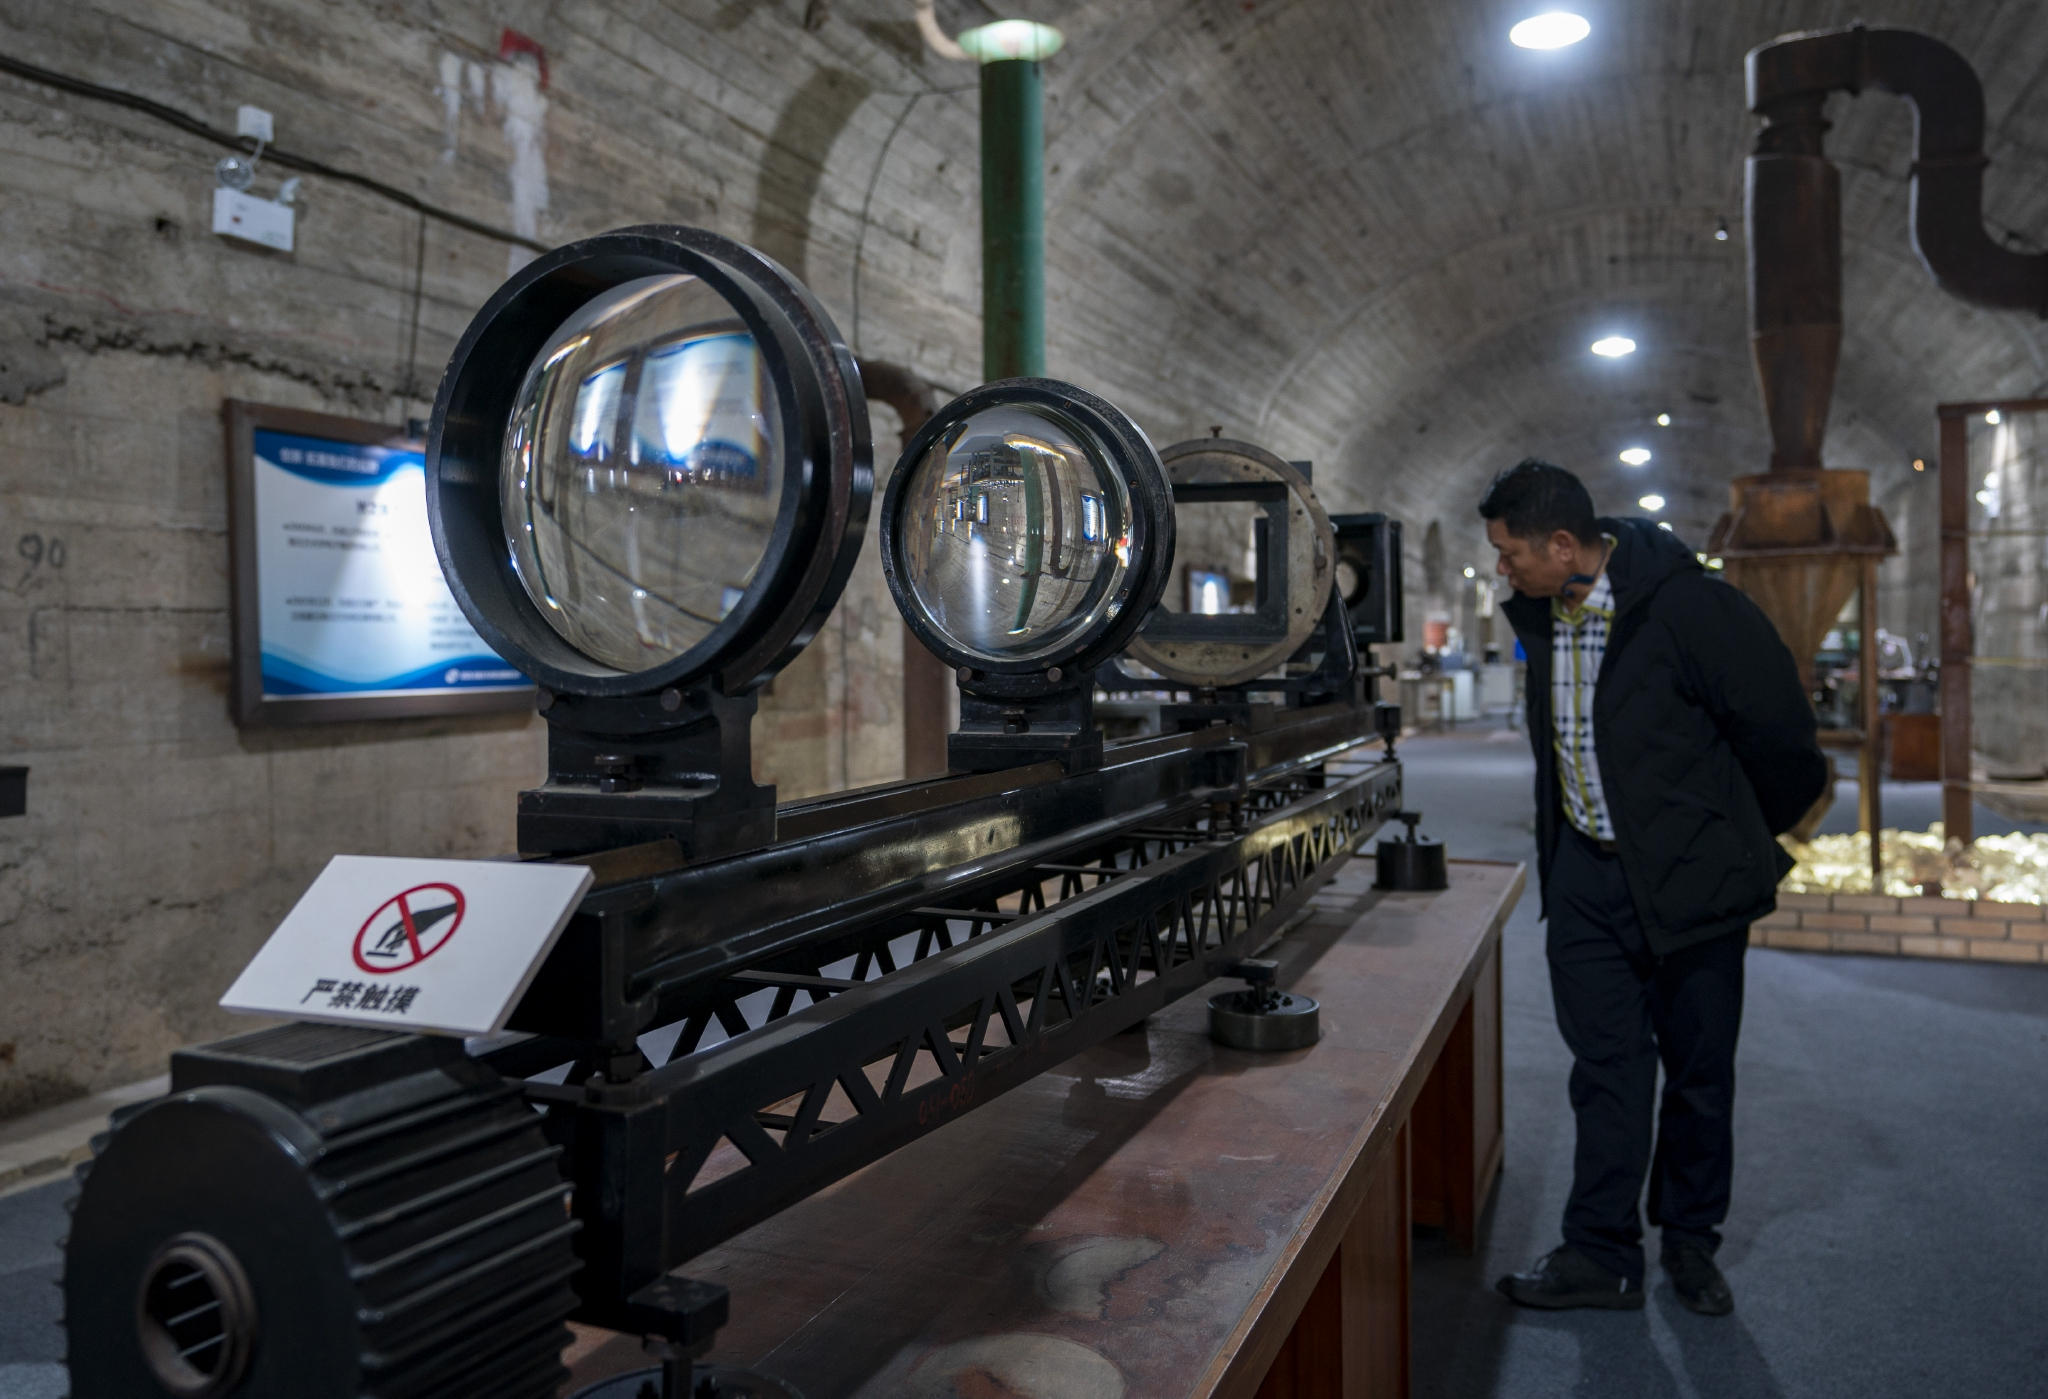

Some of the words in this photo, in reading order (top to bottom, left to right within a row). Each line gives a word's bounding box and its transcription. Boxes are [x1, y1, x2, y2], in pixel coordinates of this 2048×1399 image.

[18, 534, 66, 588] 90
[301, 979, 420, 1014] 严禁触摸
